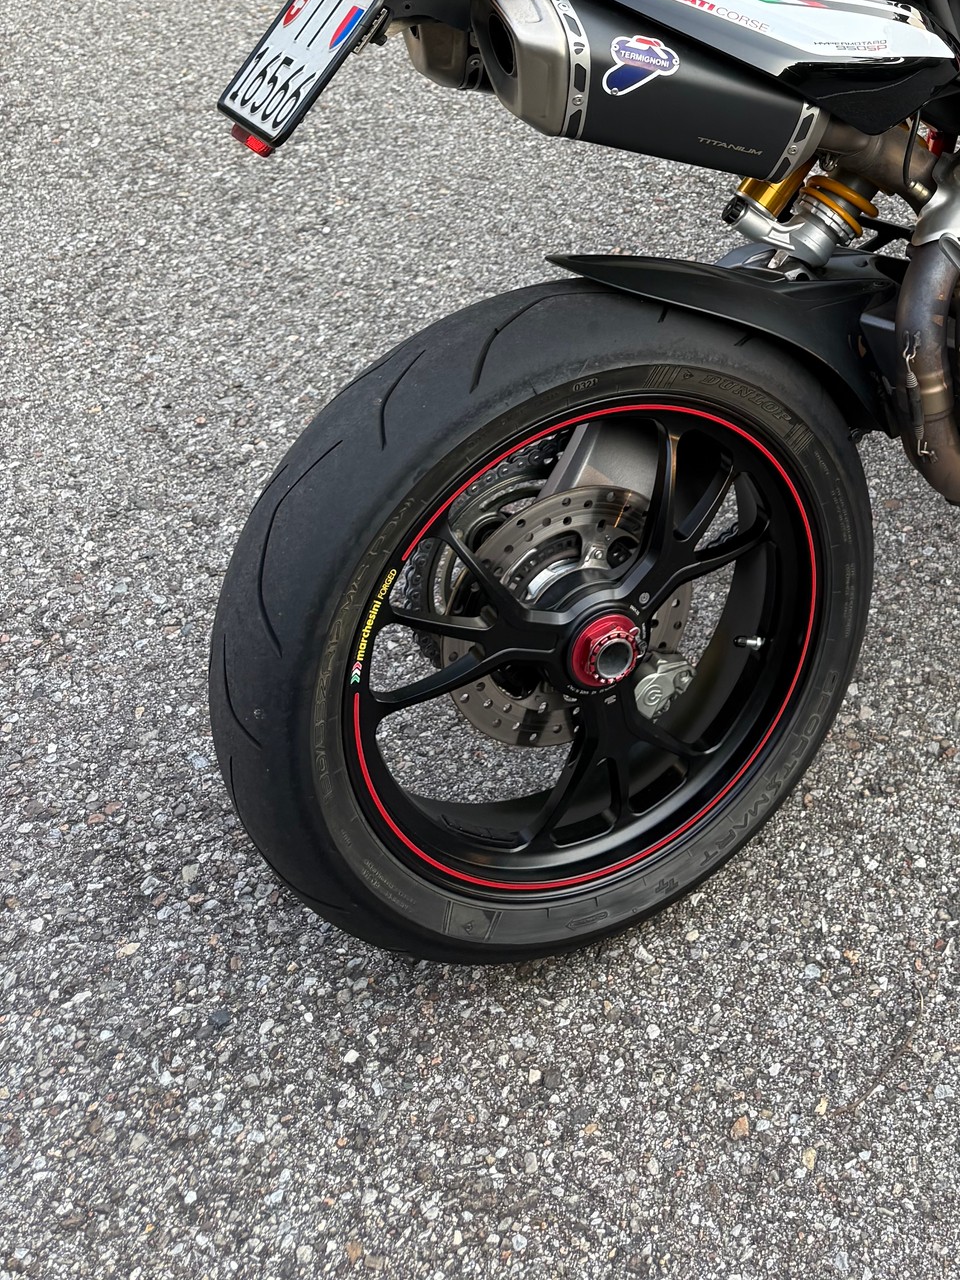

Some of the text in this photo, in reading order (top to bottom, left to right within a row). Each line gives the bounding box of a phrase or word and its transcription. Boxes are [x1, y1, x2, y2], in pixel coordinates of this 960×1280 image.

[716, 7, 770, 32] CORSE
[619, 50, 670, 68] TERMIGNONI
[229, 46, 317, 129] 16566
[697, 136, 764, 156] TITANIUM
[700, 373, 792, 423] DUNLOP
[356, 568, 397, 661] marchesini FORGED
